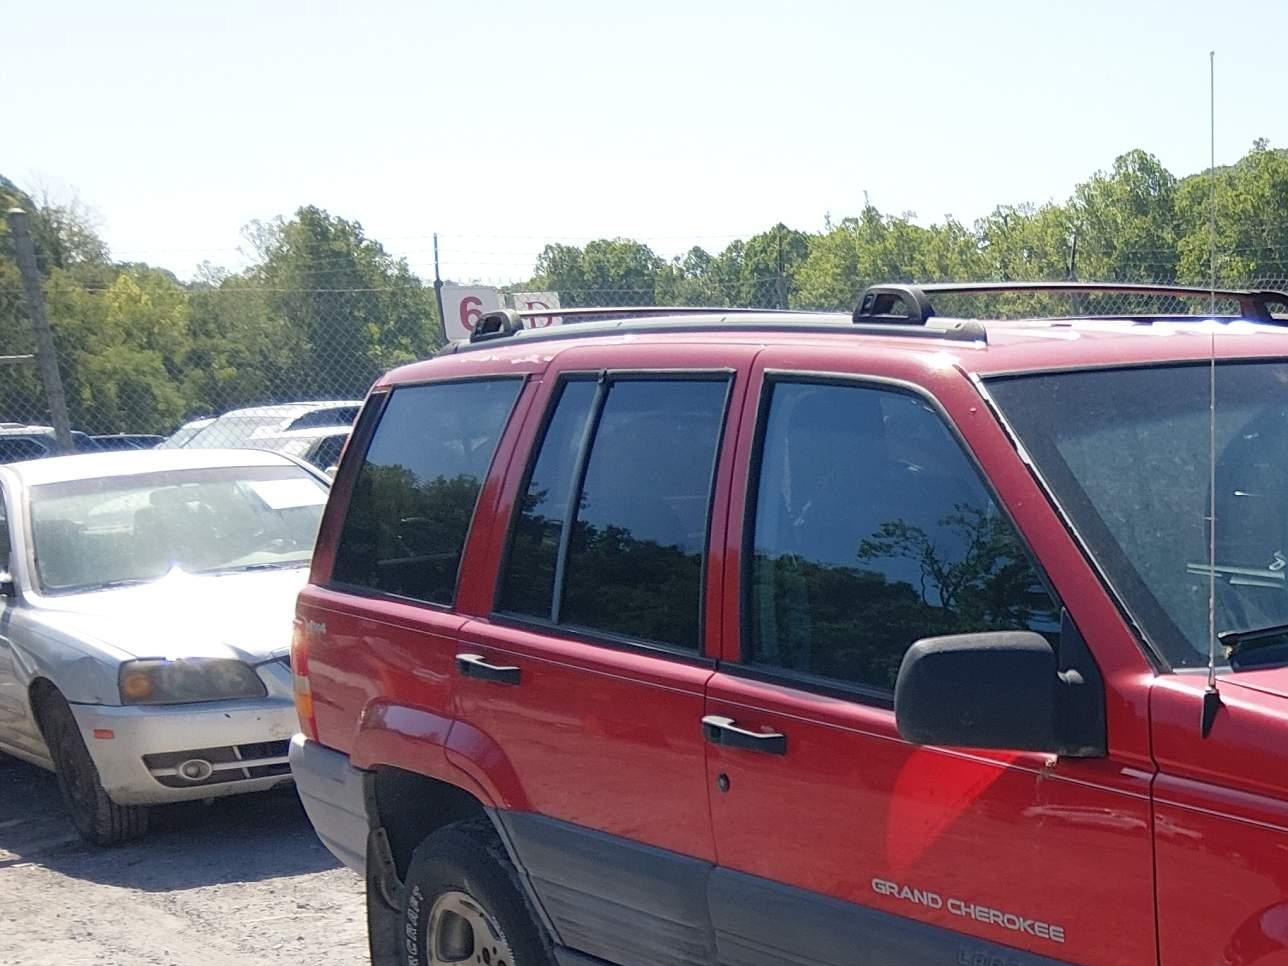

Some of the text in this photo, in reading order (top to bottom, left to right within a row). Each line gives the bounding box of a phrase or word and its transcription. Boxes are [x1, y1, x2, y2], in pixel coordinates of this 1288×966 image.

[460, 296, 482, 331] 6
[526, 301, 553, 328] D
[871, 878, 1065, 943] GRAND CHEROKEE
